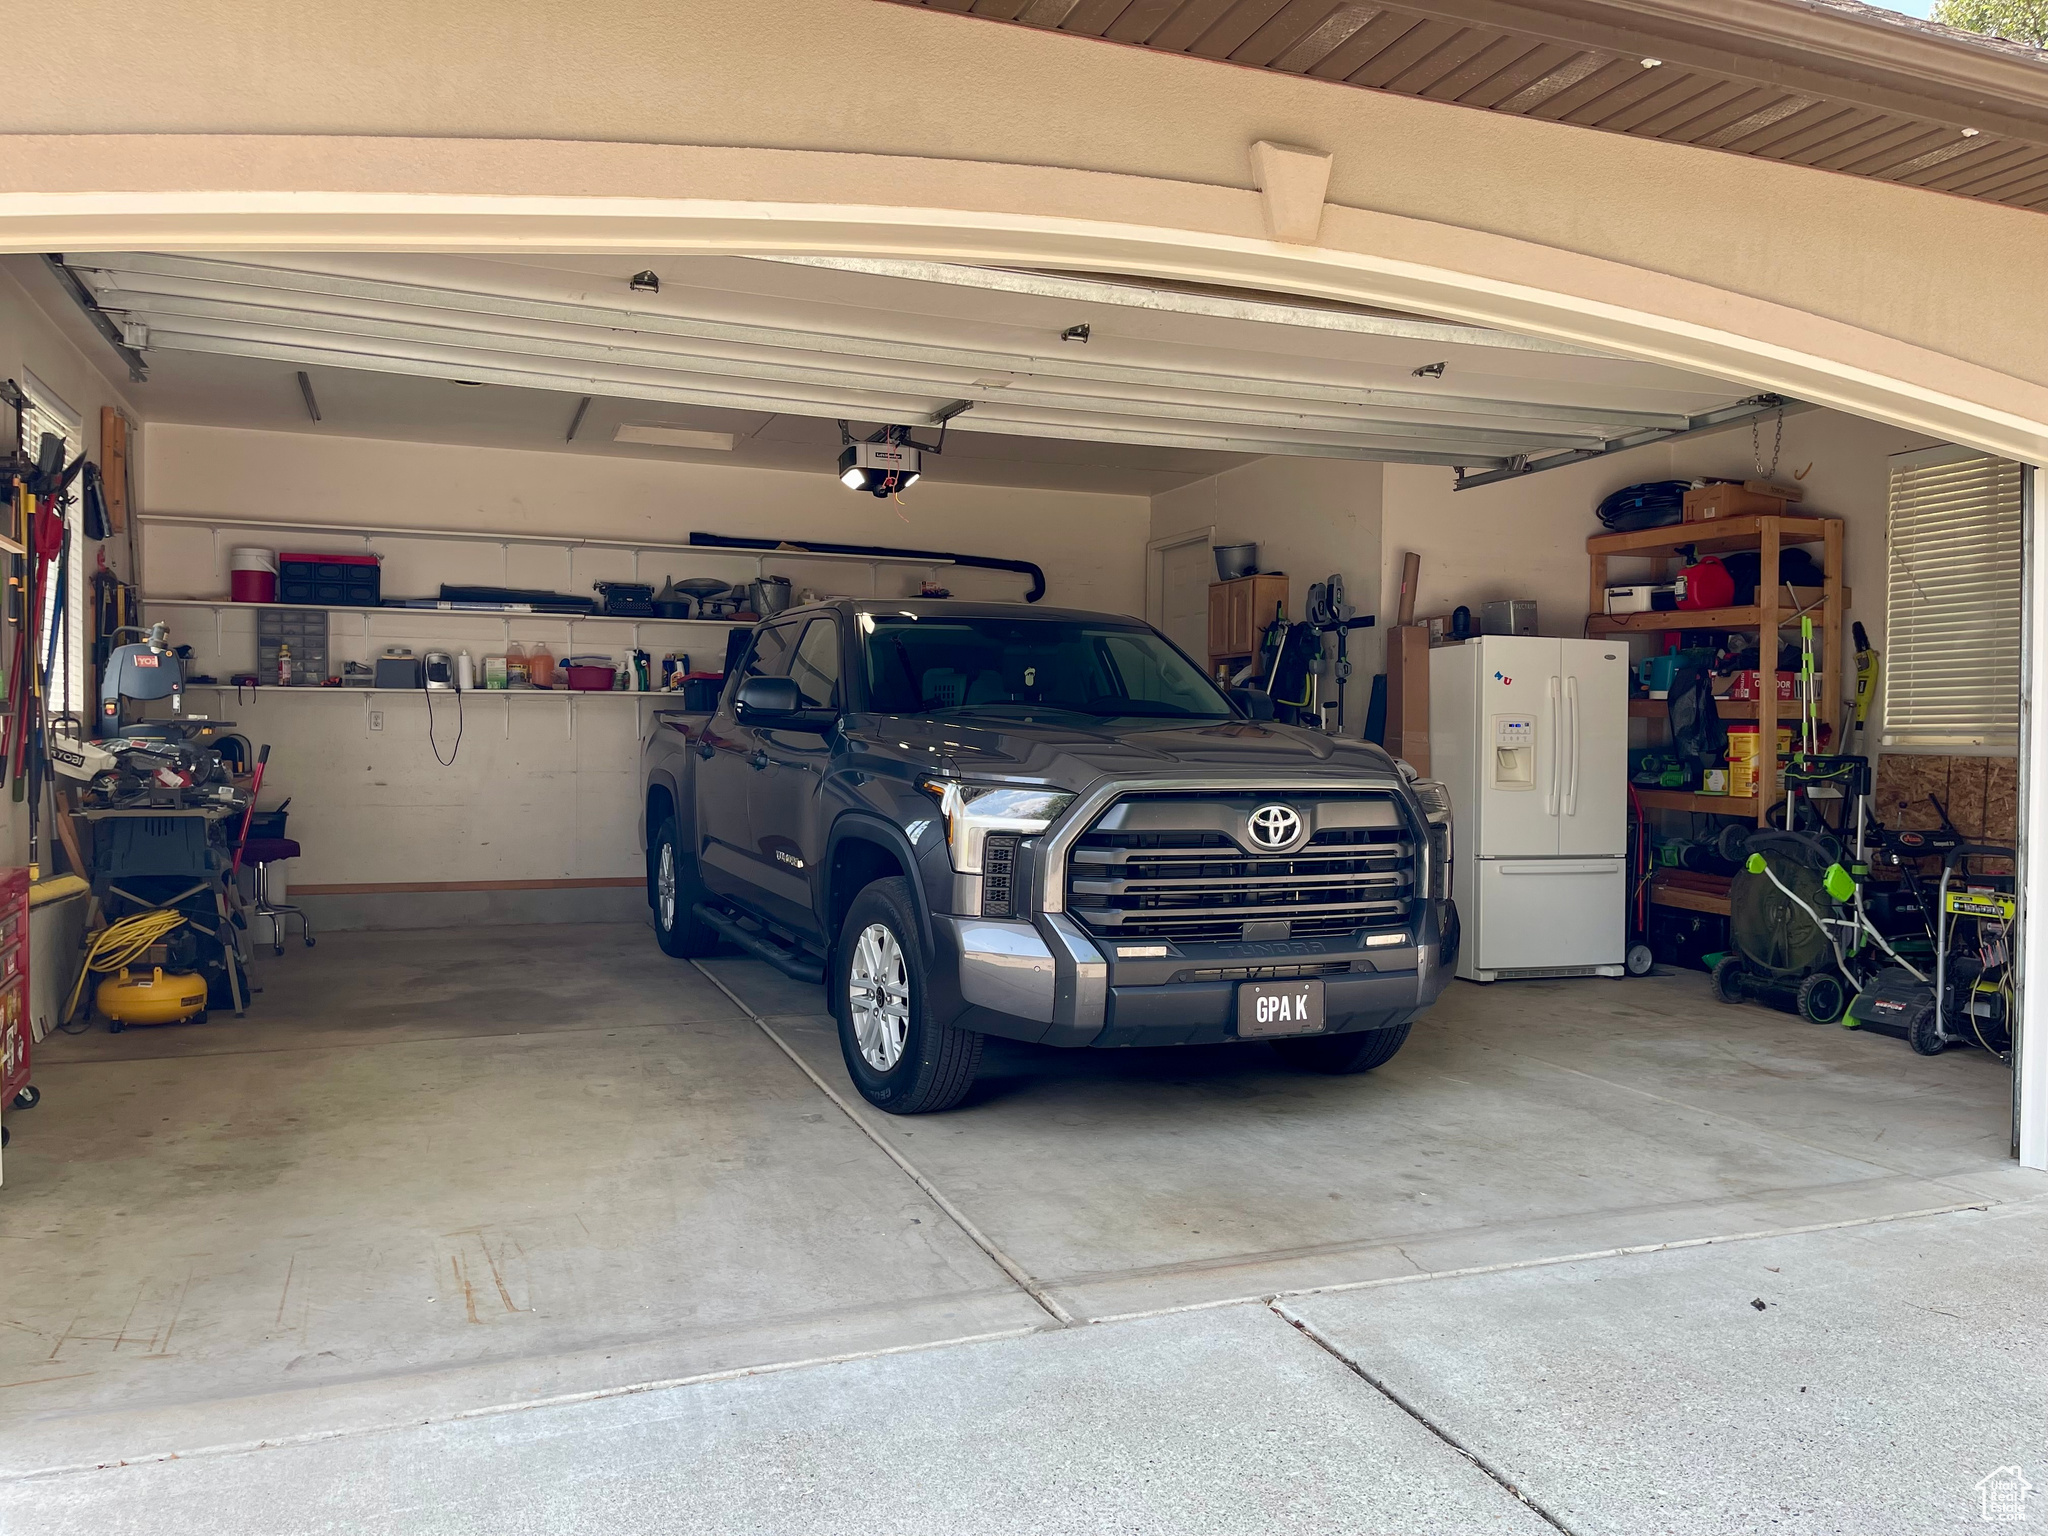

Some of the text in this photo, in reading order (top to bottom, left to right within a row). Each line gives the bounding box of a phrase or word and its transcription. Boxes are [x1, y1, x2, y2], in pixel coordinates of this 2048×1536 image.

[1218, 941, 1326, 957] TUNDRA
[1256, 994, 1308, 1023] GPA K
